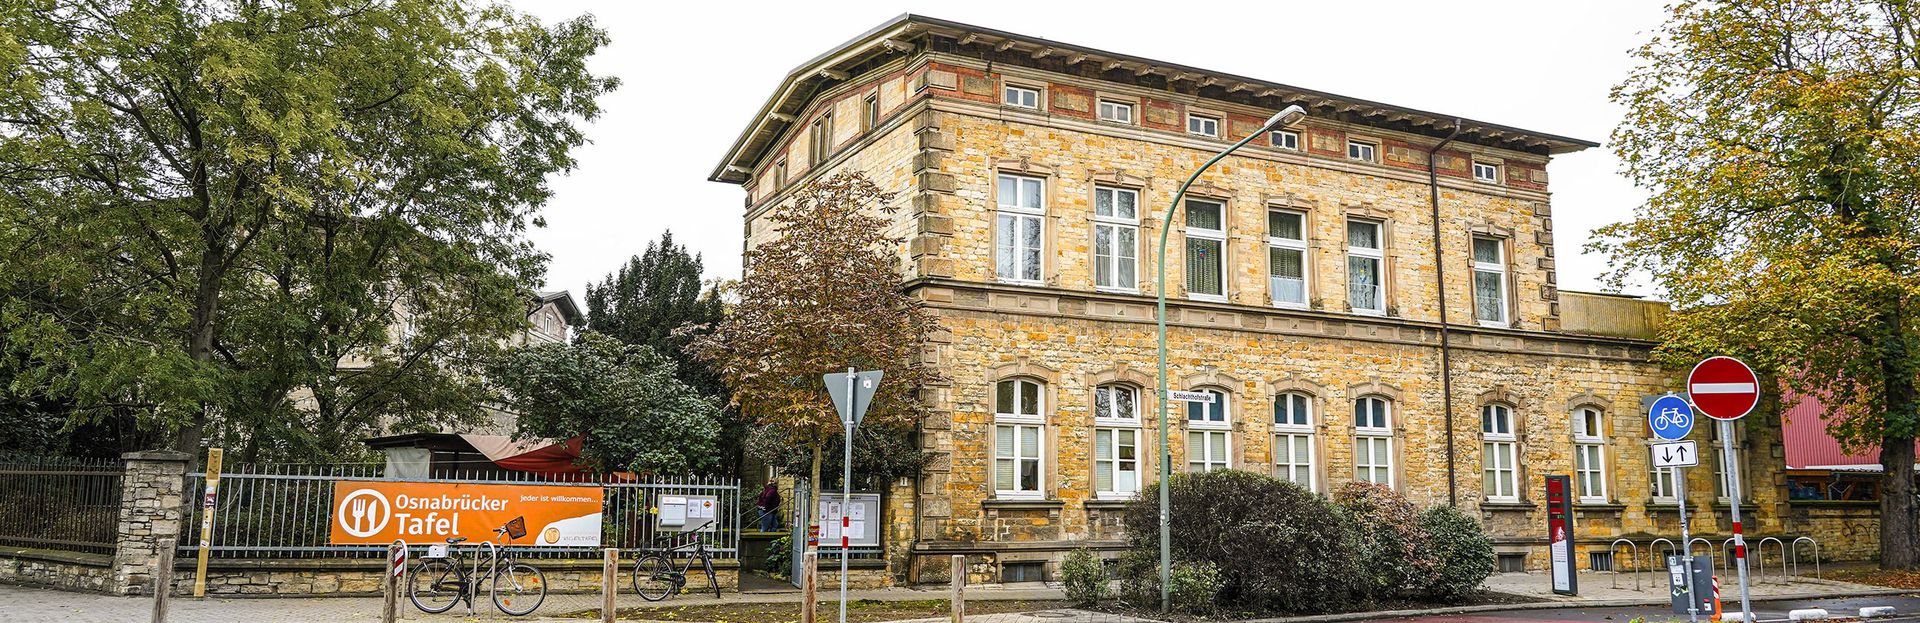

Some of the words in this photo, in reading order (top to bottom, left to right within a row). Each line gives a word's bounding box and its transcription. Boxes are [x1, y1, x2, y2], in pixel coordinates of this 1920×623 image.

[1173, 392, 1212, 401] Schlachthofstraße
[395, 493, 509, 511] Osnabrücker
[395, 512, 459, 535] Tafel
